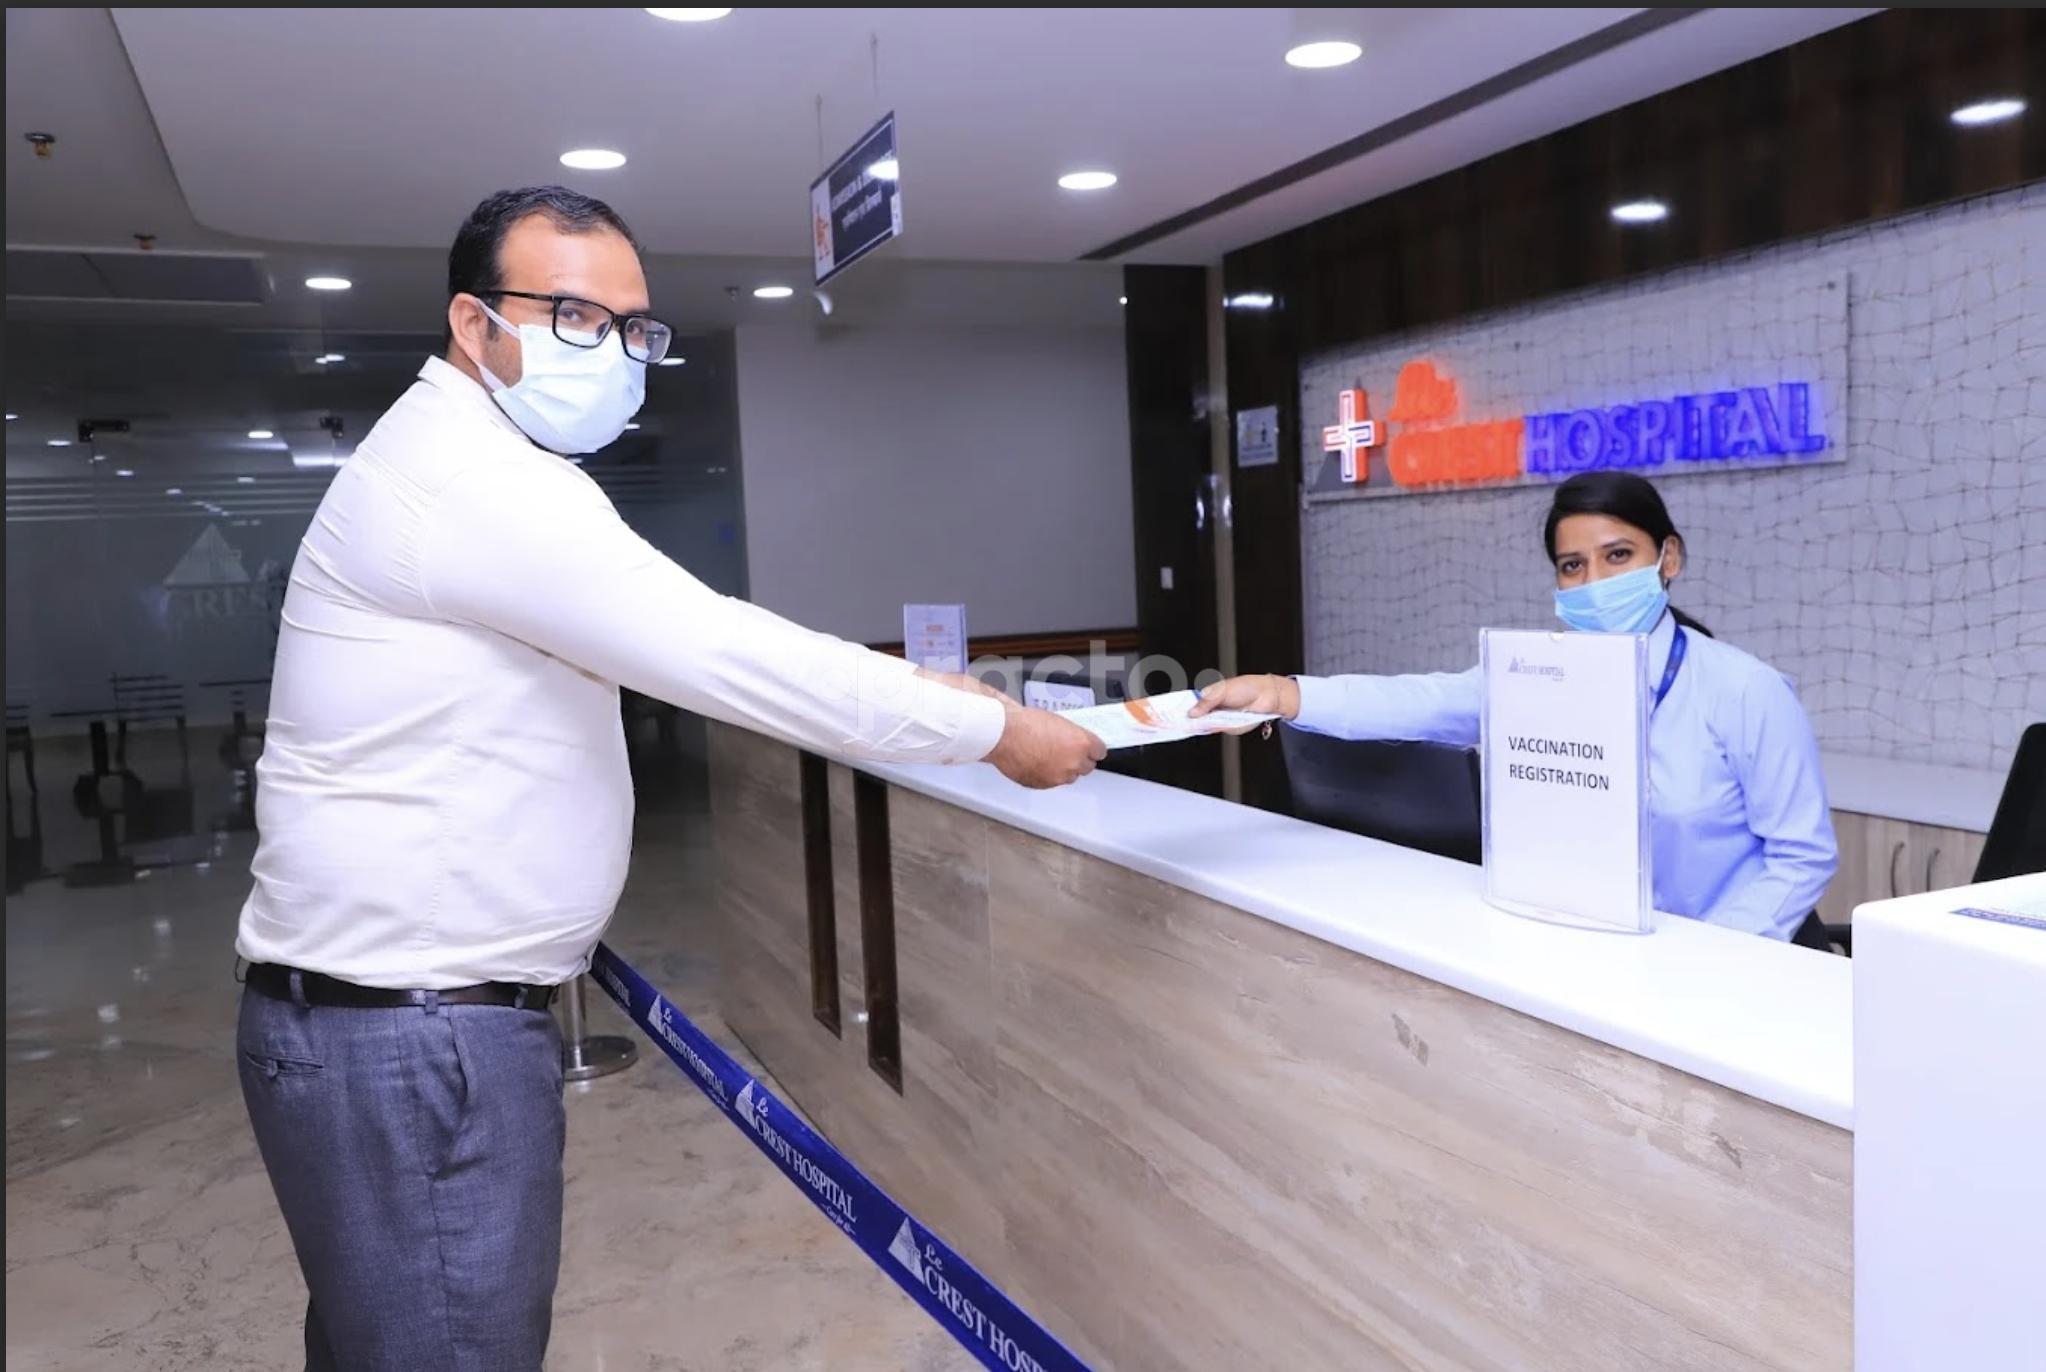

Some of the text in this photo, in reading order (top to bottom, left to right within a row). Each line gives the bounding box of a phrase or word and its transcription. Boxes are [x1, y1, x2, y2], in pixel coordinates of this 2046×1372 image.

[1525, 382, 1826, 474] HOSPITAL
[1508, 736, 1604, 760] VACCINATION
[1509, 763, 1609, 790] REGISTRATION
[755, 1115, 858, 1223] CREST HOSPITAL
[924, 1243, 943, 1272] Le
[925, 1265, 988, 1341] CREST
